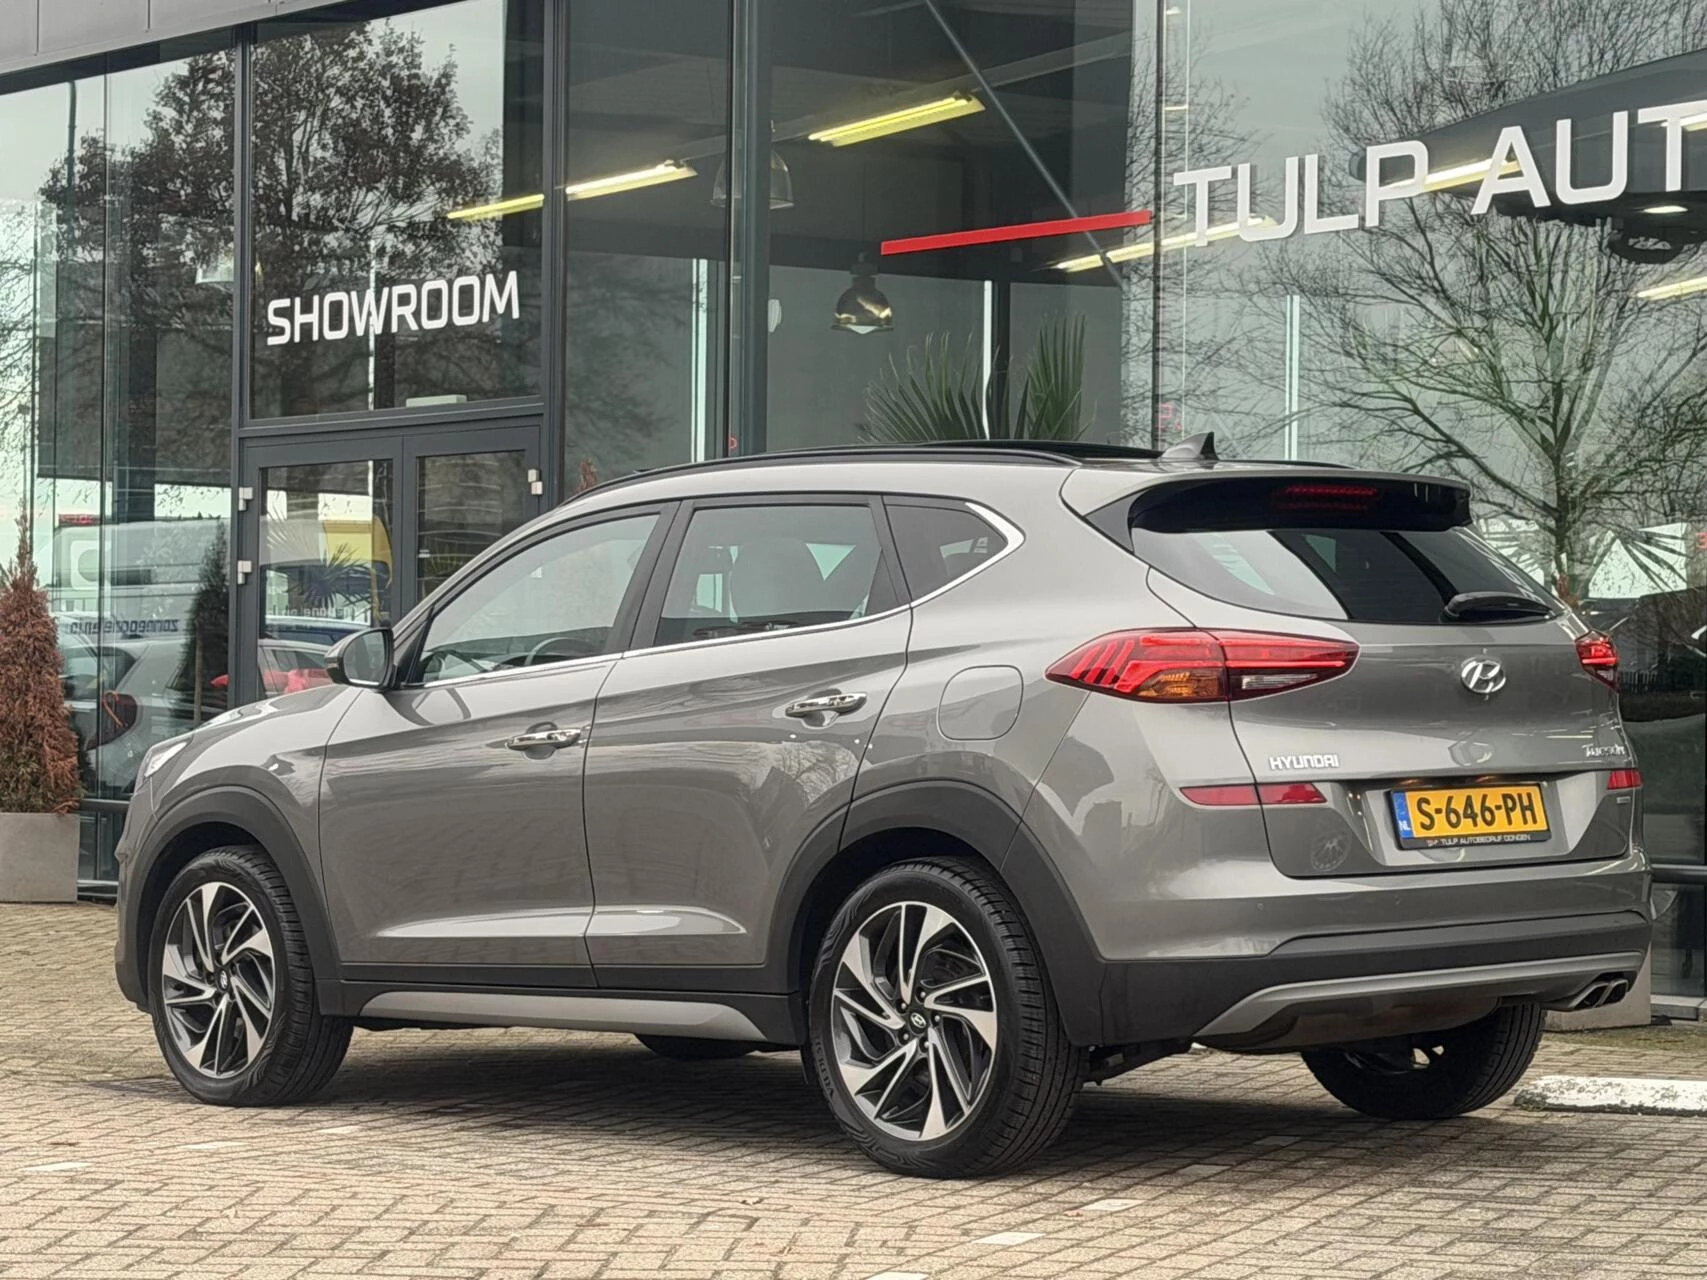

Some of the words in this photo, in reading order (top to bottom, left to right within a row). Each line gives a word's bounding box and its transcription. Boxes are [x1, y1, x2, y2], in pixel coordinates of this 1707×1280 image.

[1174, 140, 1429, 246] TULP
[1472, 101, 1707, 215] AUT
[267, 270, 521, 346] SHOWROOM
[1269, 754, 1339, 769] HYUNDAI
[1399, 820, 1410, 831] NL
[1416, 792, 1537, 830] S-646-PH
